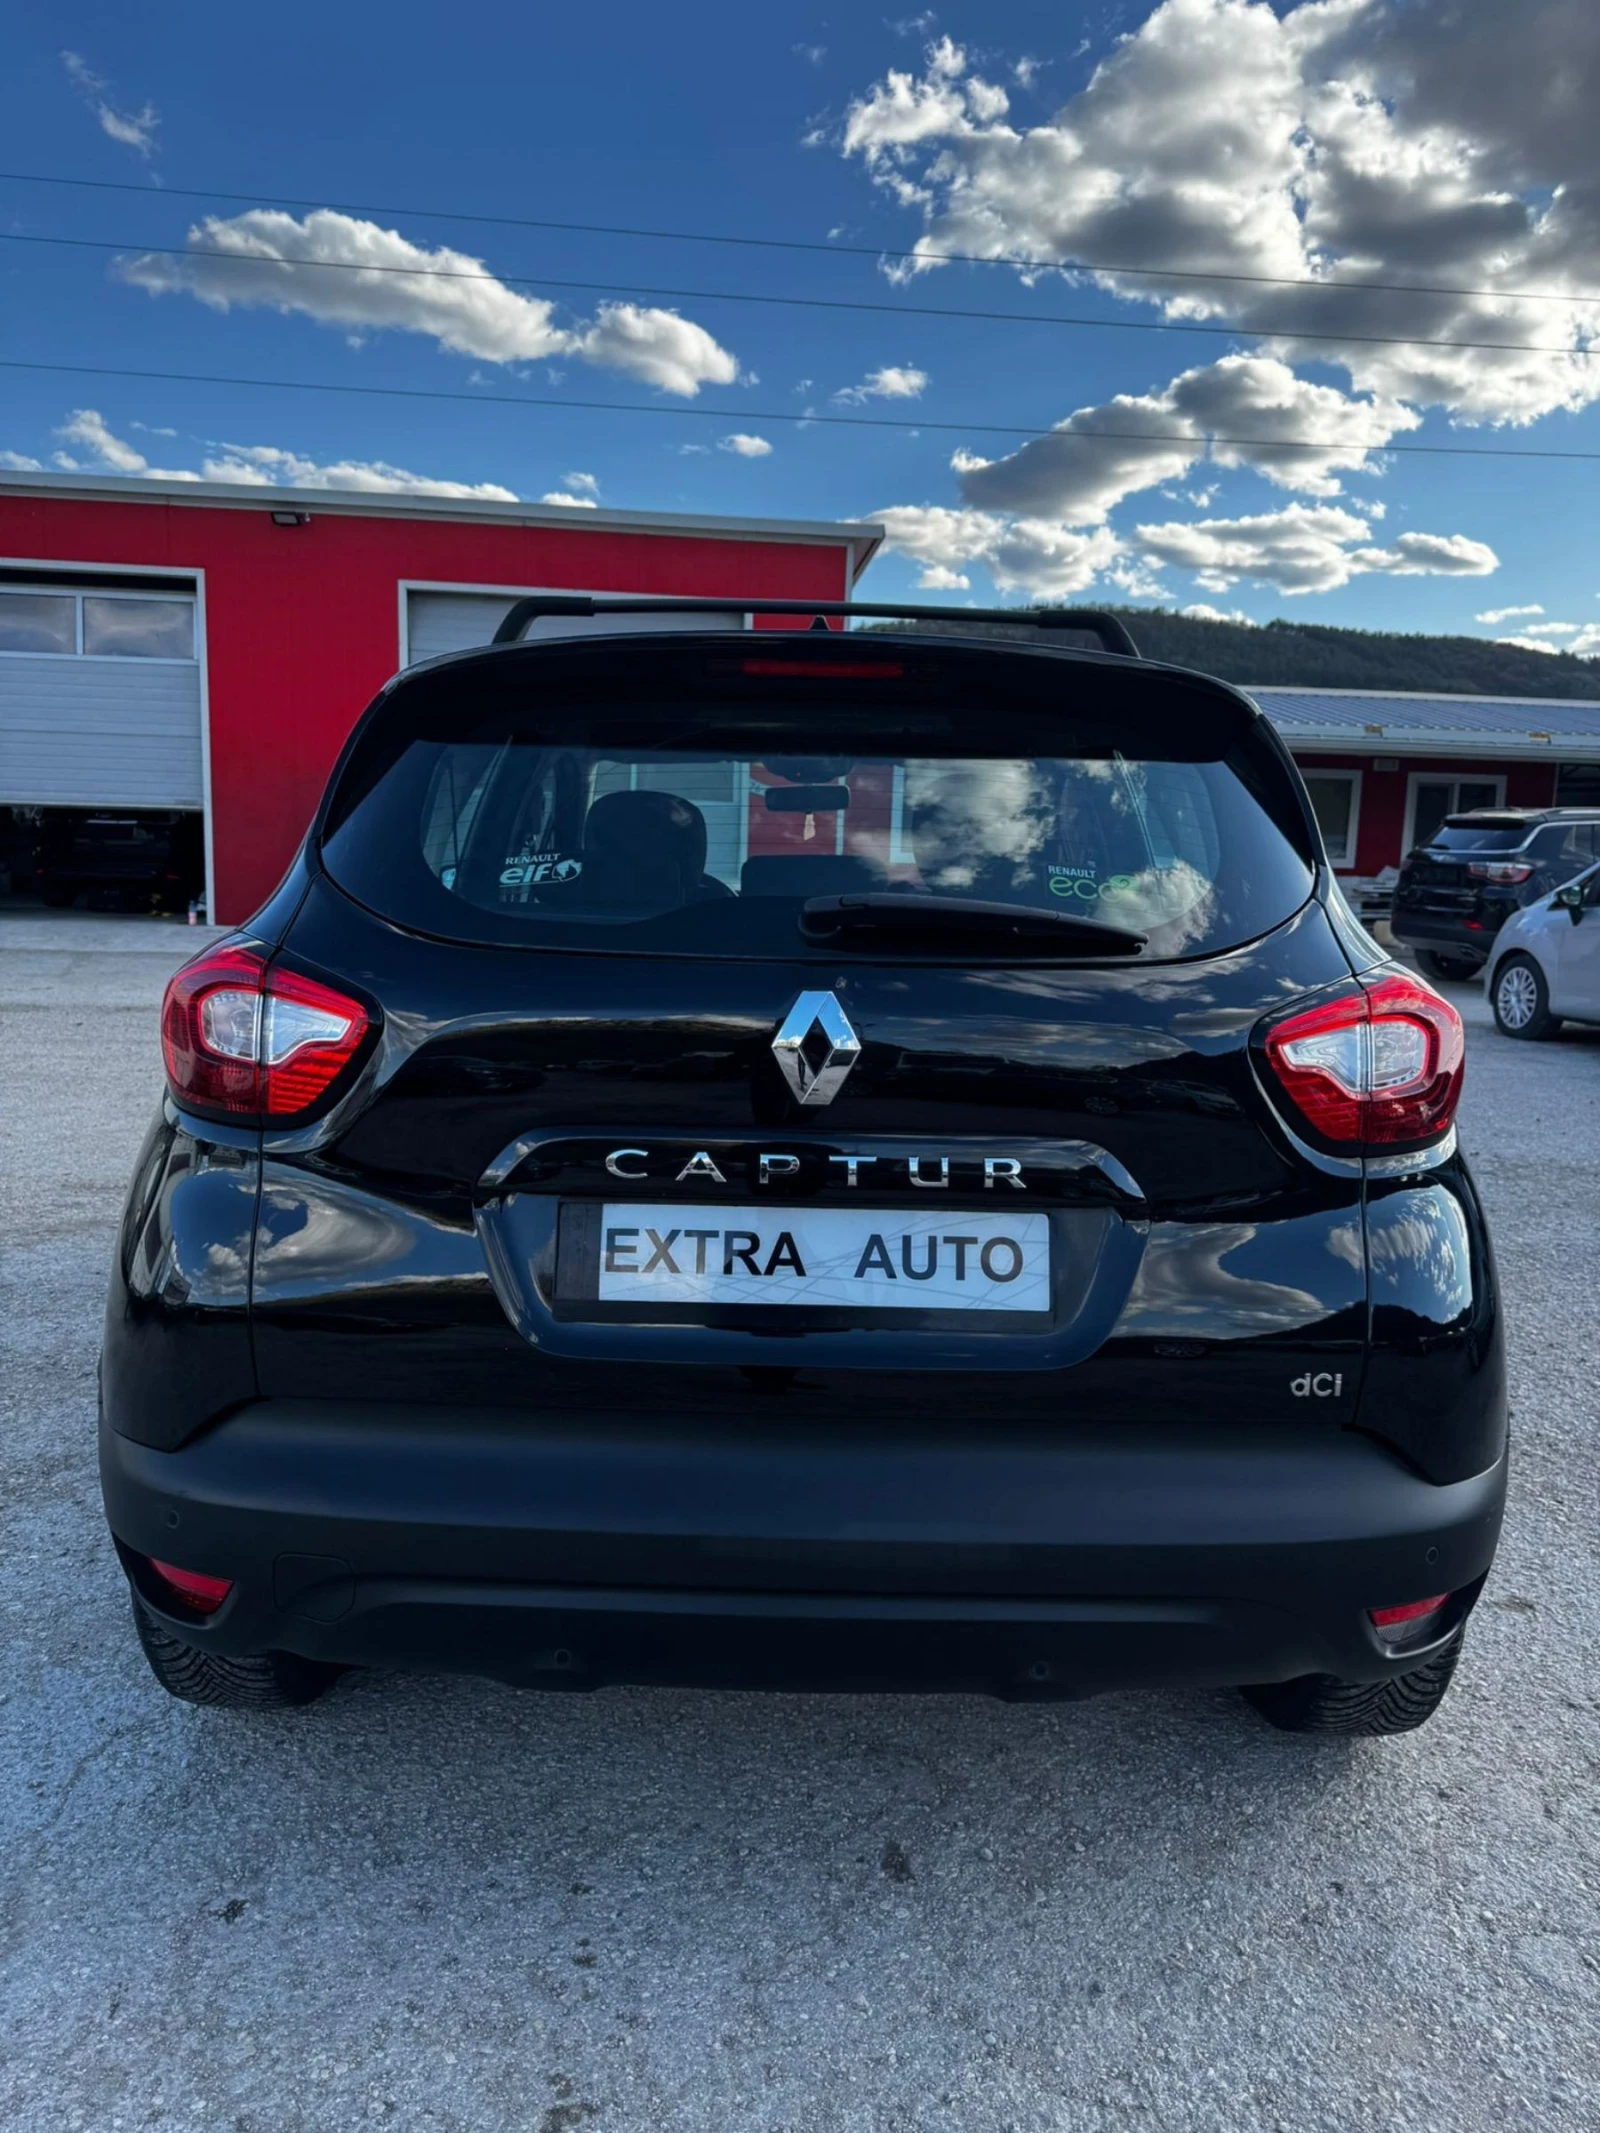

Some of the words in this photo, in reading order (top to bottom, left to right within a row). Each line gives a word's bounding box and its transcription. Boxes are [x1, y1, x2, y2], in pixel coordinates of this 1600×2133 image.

[505, 853, 561, 865] RENAULT
[500, 863, 553, 884] elf
[1048, 865, 1096, 879] RENAULT
[605, 1148, 1027, 1189] CAPTUR
[604, 1227, 806, 1277] EXTRA
[854, 1233, 1025, 1283] AUTO
